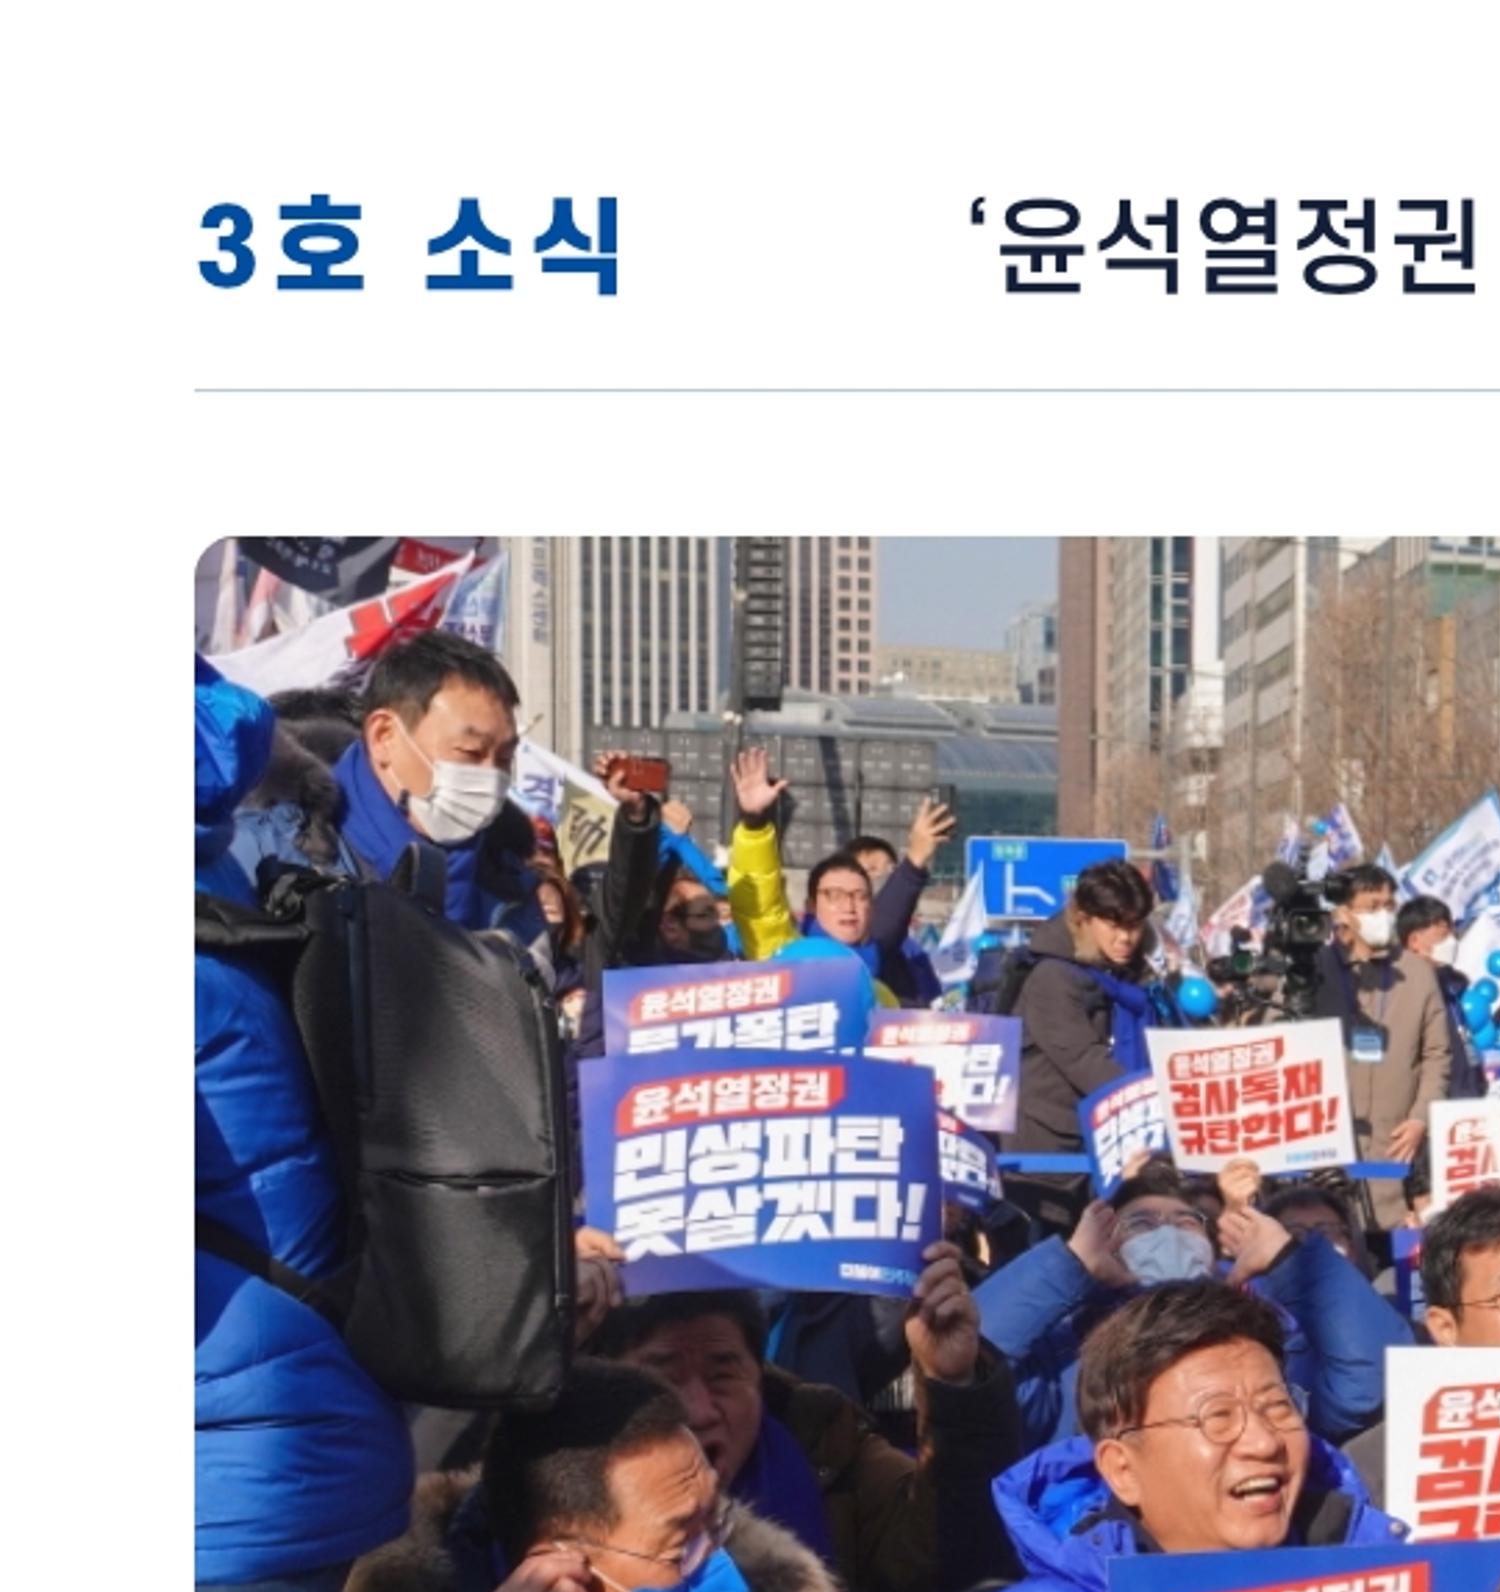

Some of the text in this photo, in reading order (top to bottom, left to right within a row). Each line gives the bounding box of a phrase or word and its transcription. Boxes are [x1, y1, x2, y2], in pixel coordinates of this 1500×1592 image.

[639, 973, 782, 1022] 윤석열정권
[633, 1073, 830, 1127] 윤석열정권
[1169, 1060, 1323, 1118] 검사독재
[1178, 1097, 1340, 1155] 규탄한다!
[614, 1117, 904, 1201] 민생파탄
[614, 1180, 927, 1262] 못살겠다!
